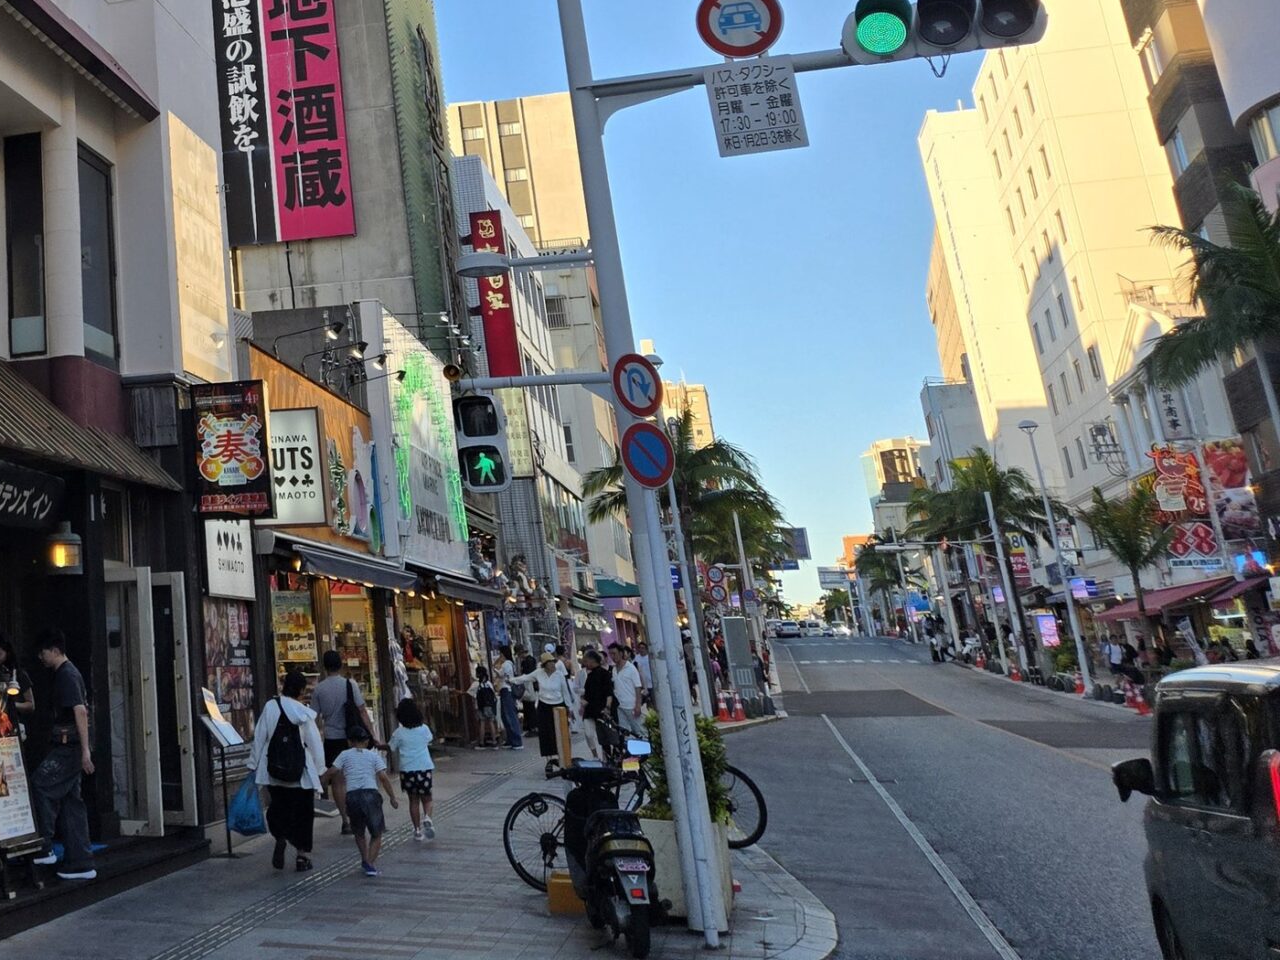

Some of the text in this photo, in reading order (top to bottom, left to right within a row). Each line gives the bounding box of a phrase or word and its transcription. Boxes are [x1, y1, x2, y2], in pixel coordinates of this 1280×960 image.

[714, 77, 791, 100] 許可車を除く
[717, 100, 744, 117] 月曜
[766, 93, 794, 110] 金曜
[720, 115, 751, 133] 17:30
[765, 109, 797, 127] 19:00
[209, 430, 256, 465] 奏
[1188, 497, 1205, 512] 2F
